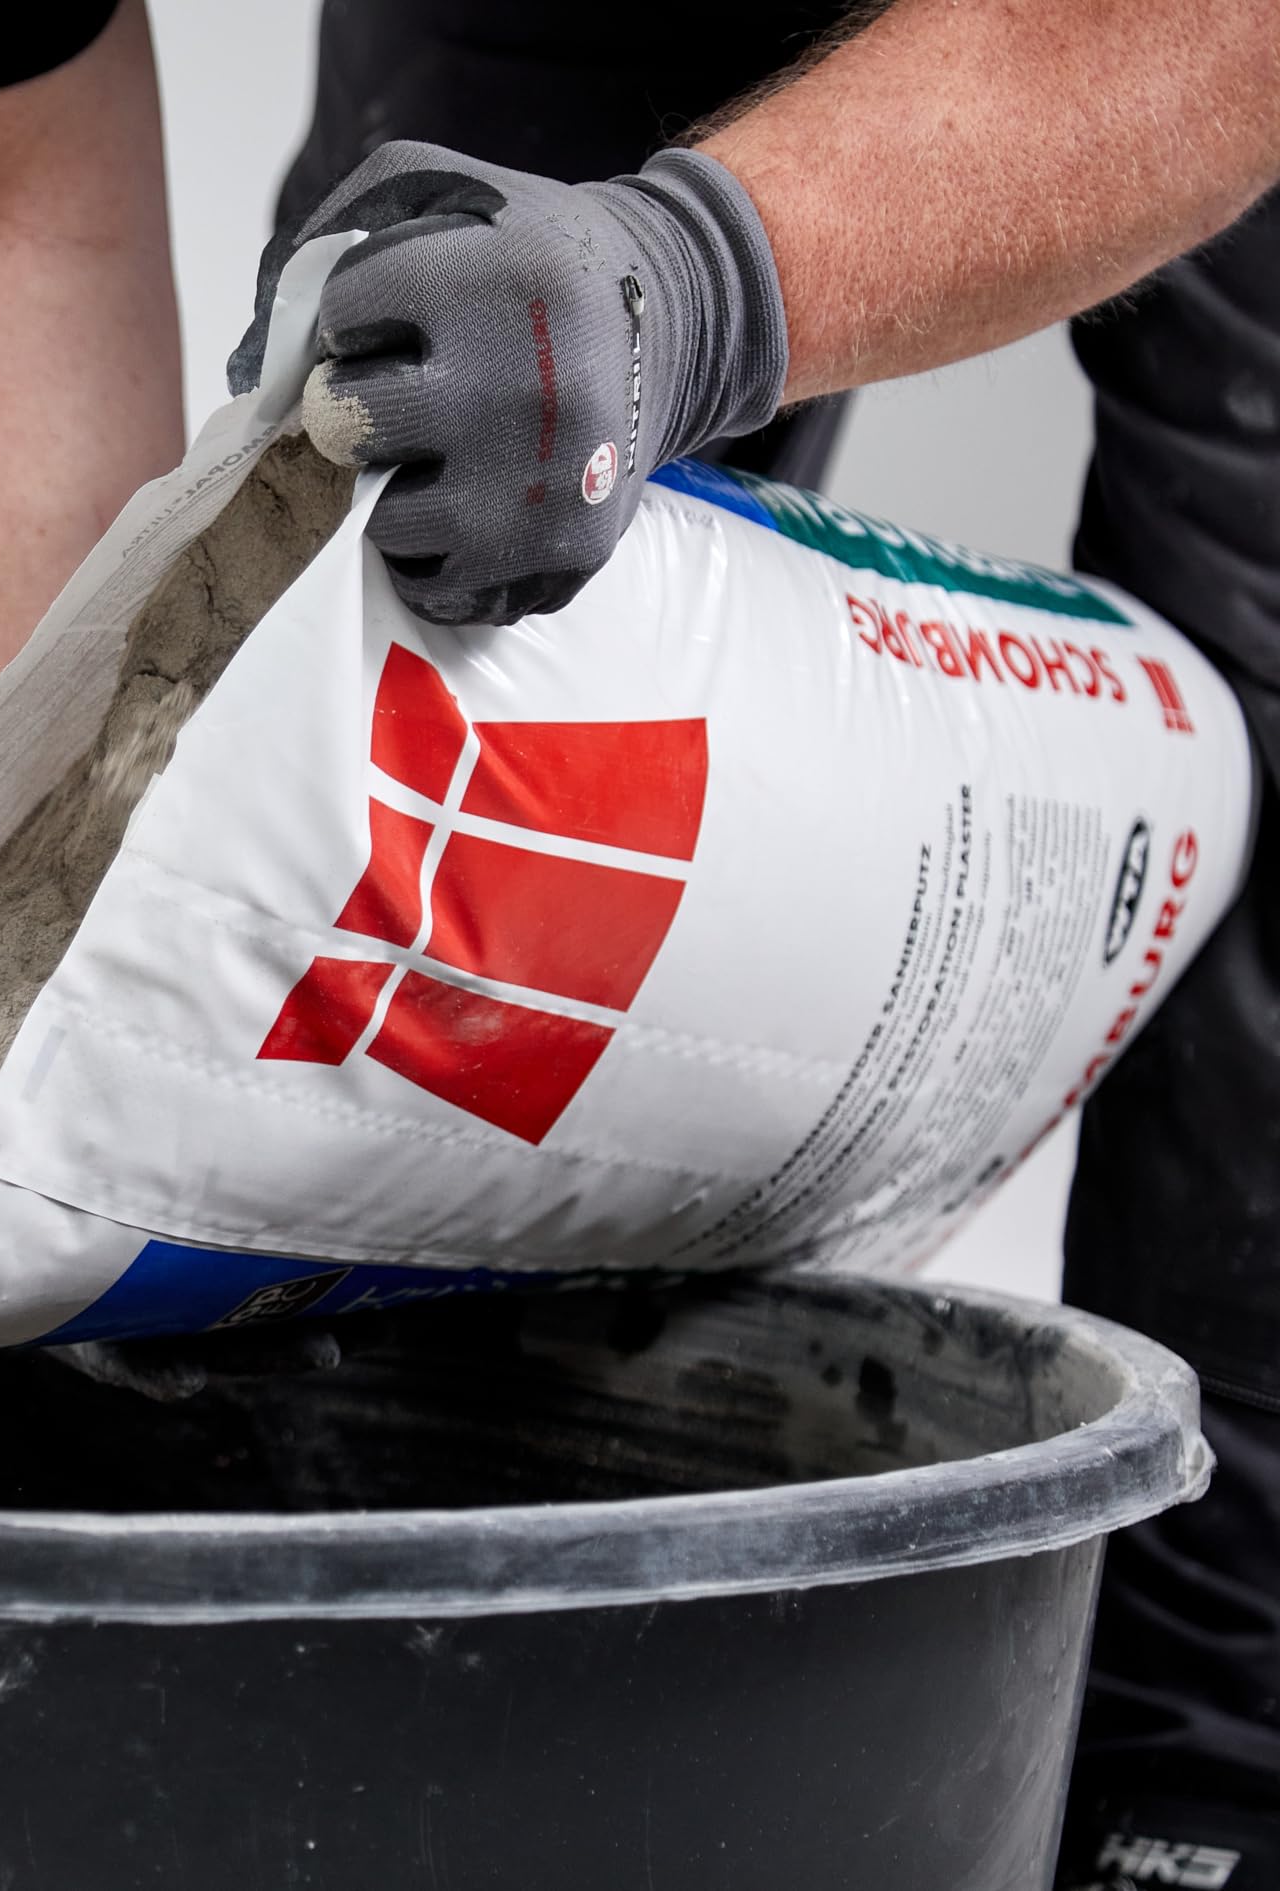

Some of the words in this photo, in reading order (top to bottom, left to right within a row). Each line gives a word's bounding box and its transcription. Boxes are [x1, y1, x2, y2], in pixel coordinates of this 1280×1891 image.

[845, 593, 1127, 703] SCHOMBURG
[956, 783, 972, 899] PLASTER
[882, 843, 931, 1015] SANIERPUTZ
